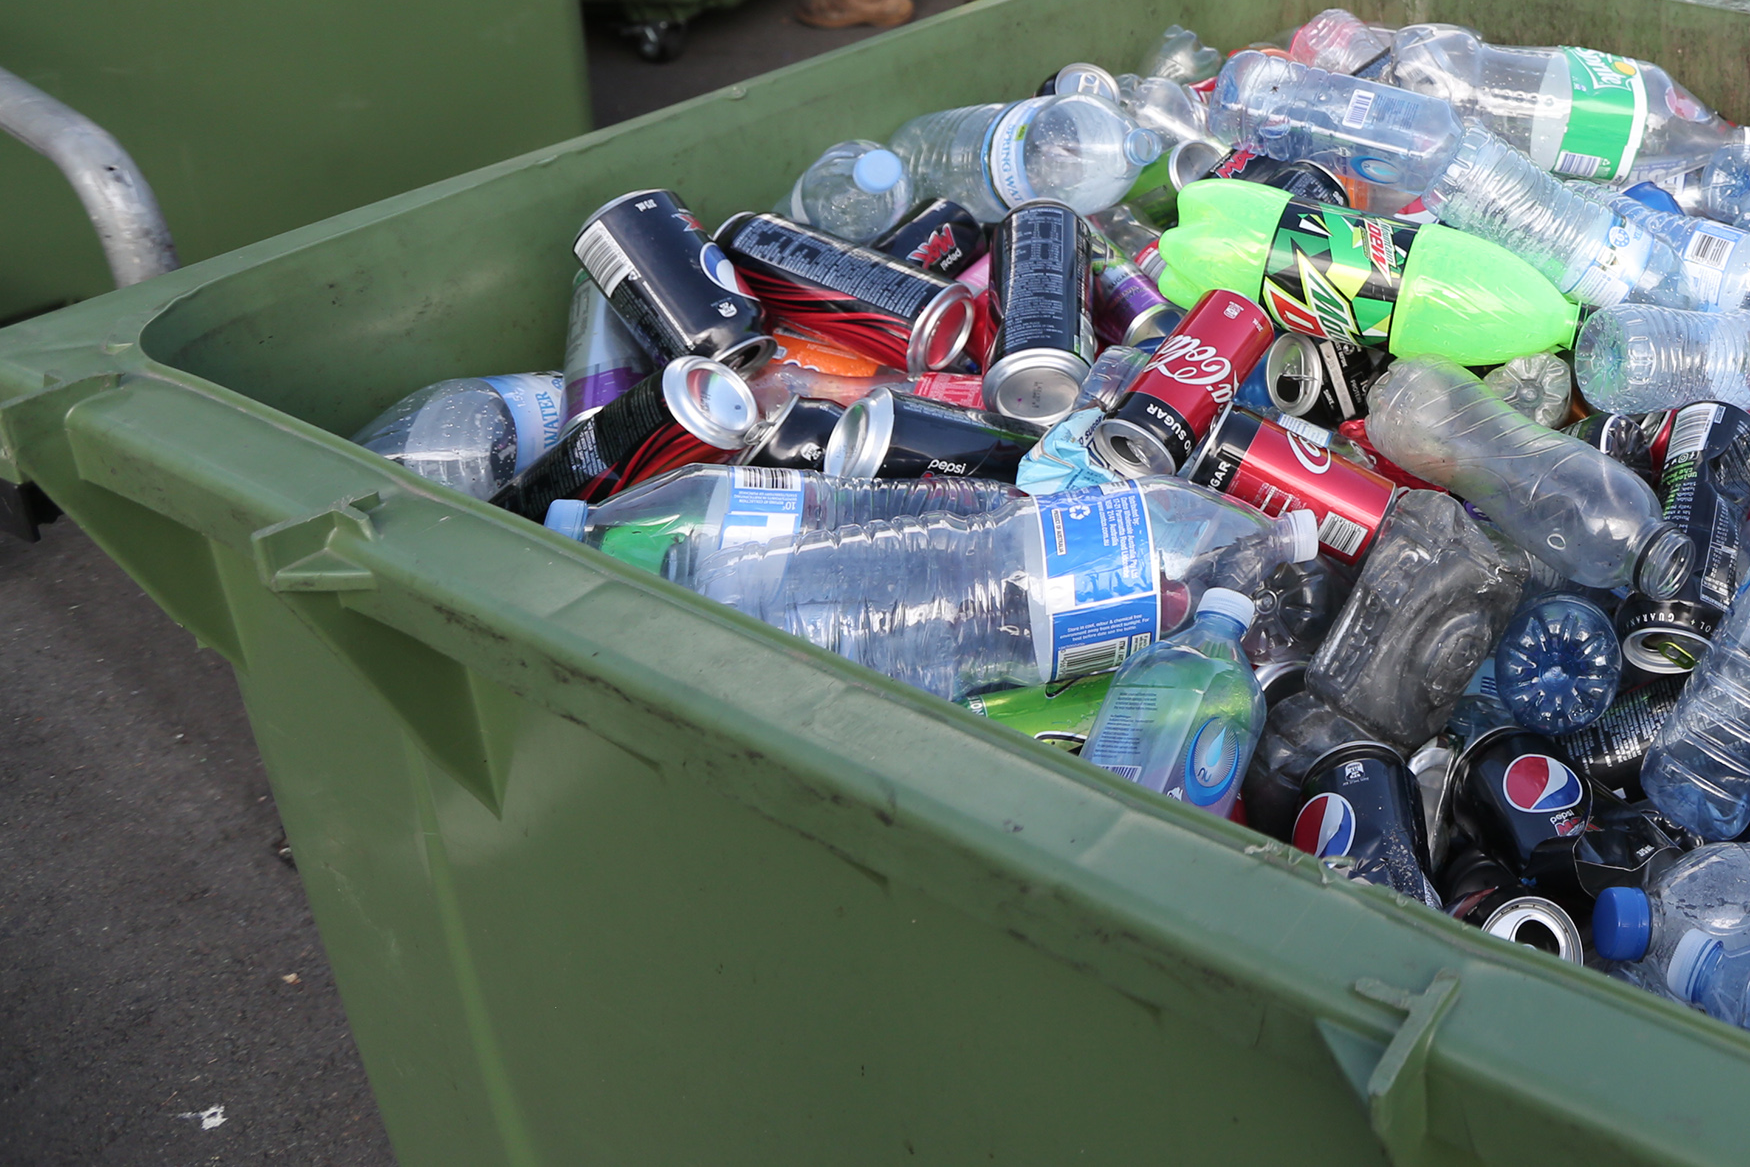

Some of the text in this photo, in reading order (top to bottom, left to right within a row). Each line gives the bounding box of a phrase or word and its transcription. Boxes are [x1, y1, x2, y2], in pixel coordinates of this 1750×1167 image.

[535, 391, 559, 449] WATER
[1146, 403, 1187, 441] SUGAR
[929, 457, 967, 474] pepsi
[1209, 461, 1231, 493] GAR
[1108, 523, 1118, 546] Australia
[1119, 536, 1127, 550] Road
[1126, 534, 1138, 559] Australia
